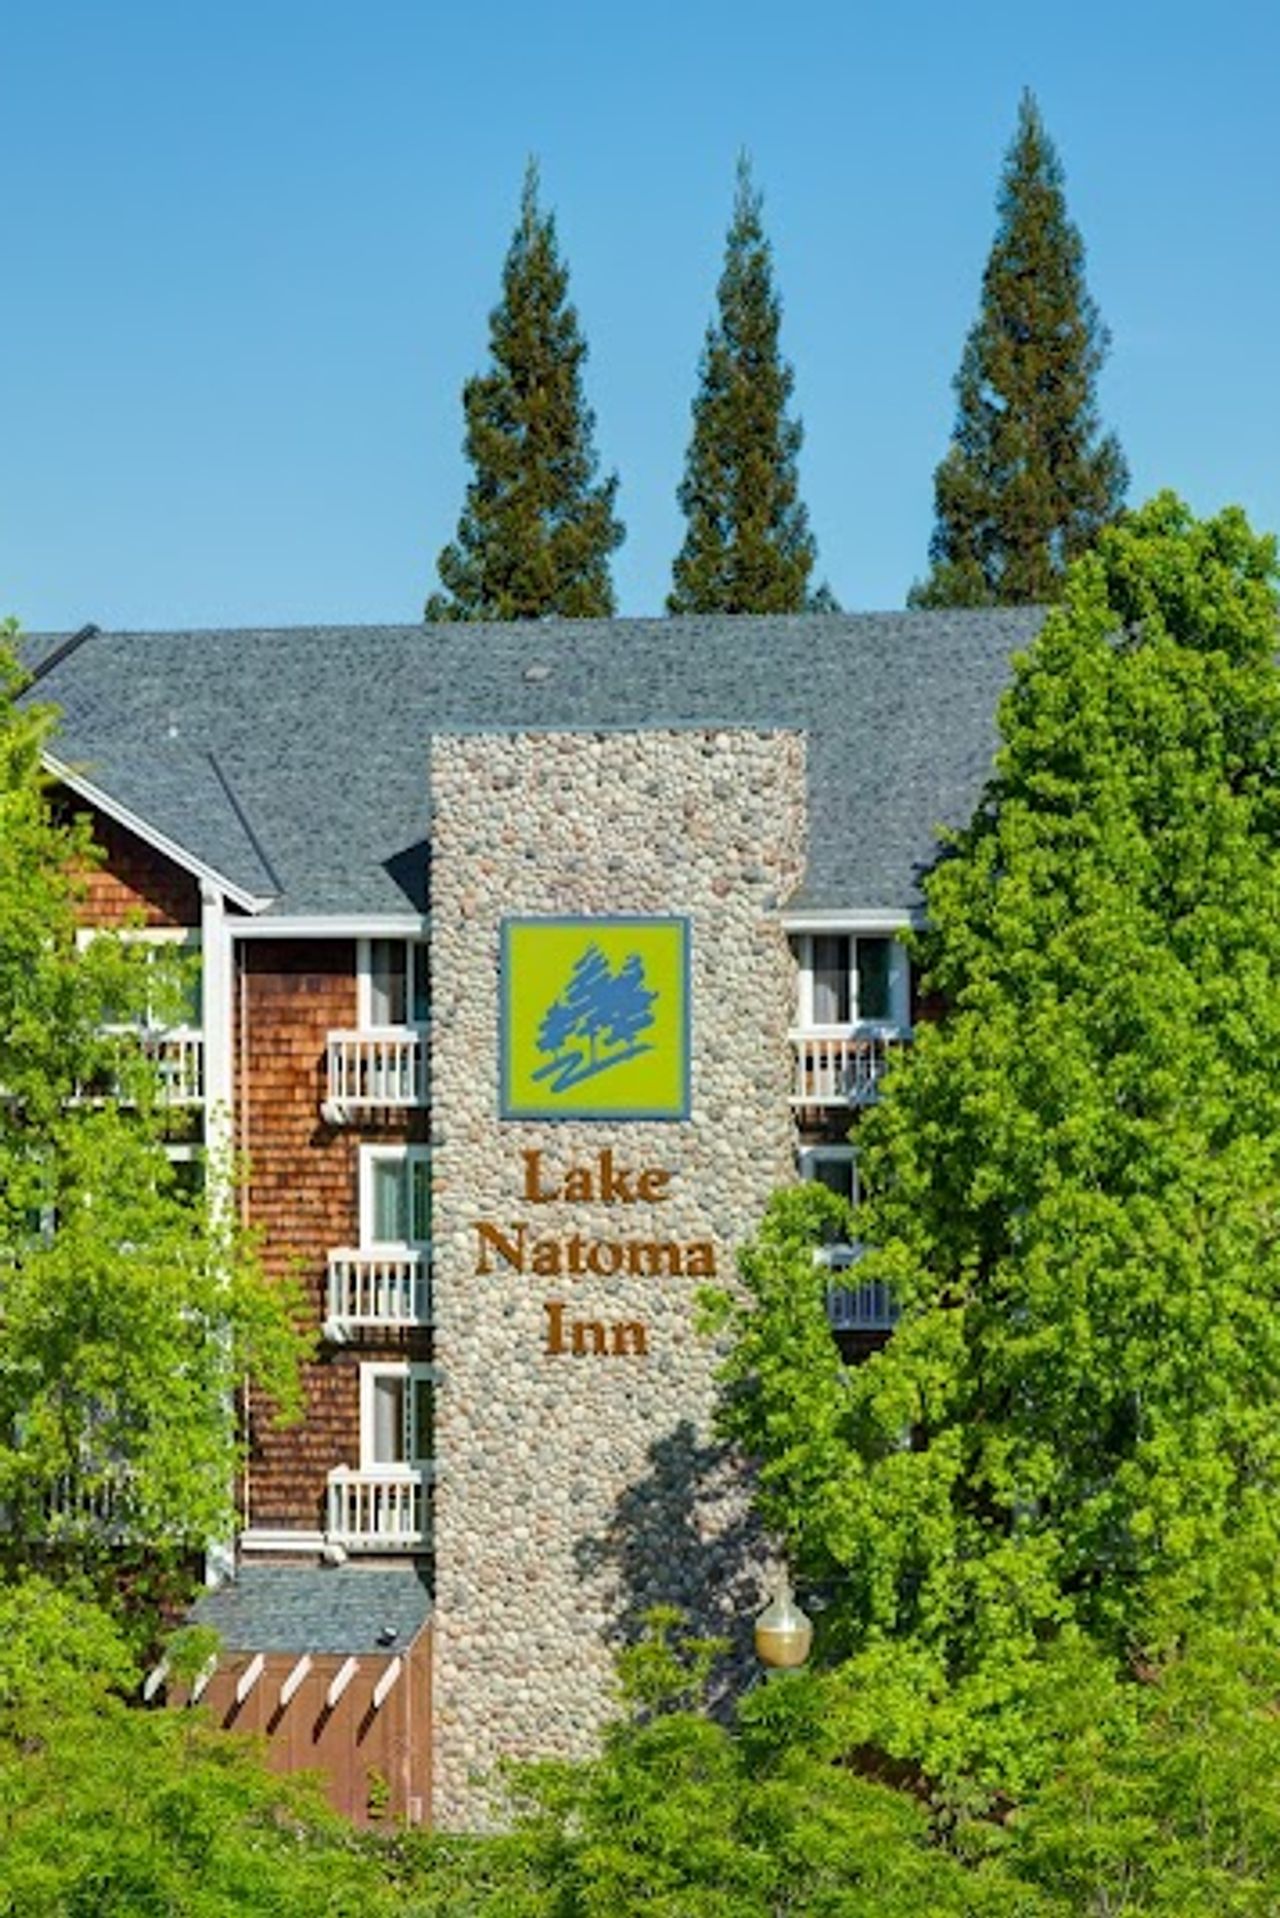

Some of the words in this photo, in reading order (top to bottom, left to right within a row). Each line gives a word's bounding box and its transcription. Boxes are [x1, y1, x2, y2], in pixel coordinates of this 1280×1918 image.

[520, 1148, 672, 1203] Lake
[471, 1221, 717, 1277] Natoma
[543, 1300, 649, 1356] Inn
